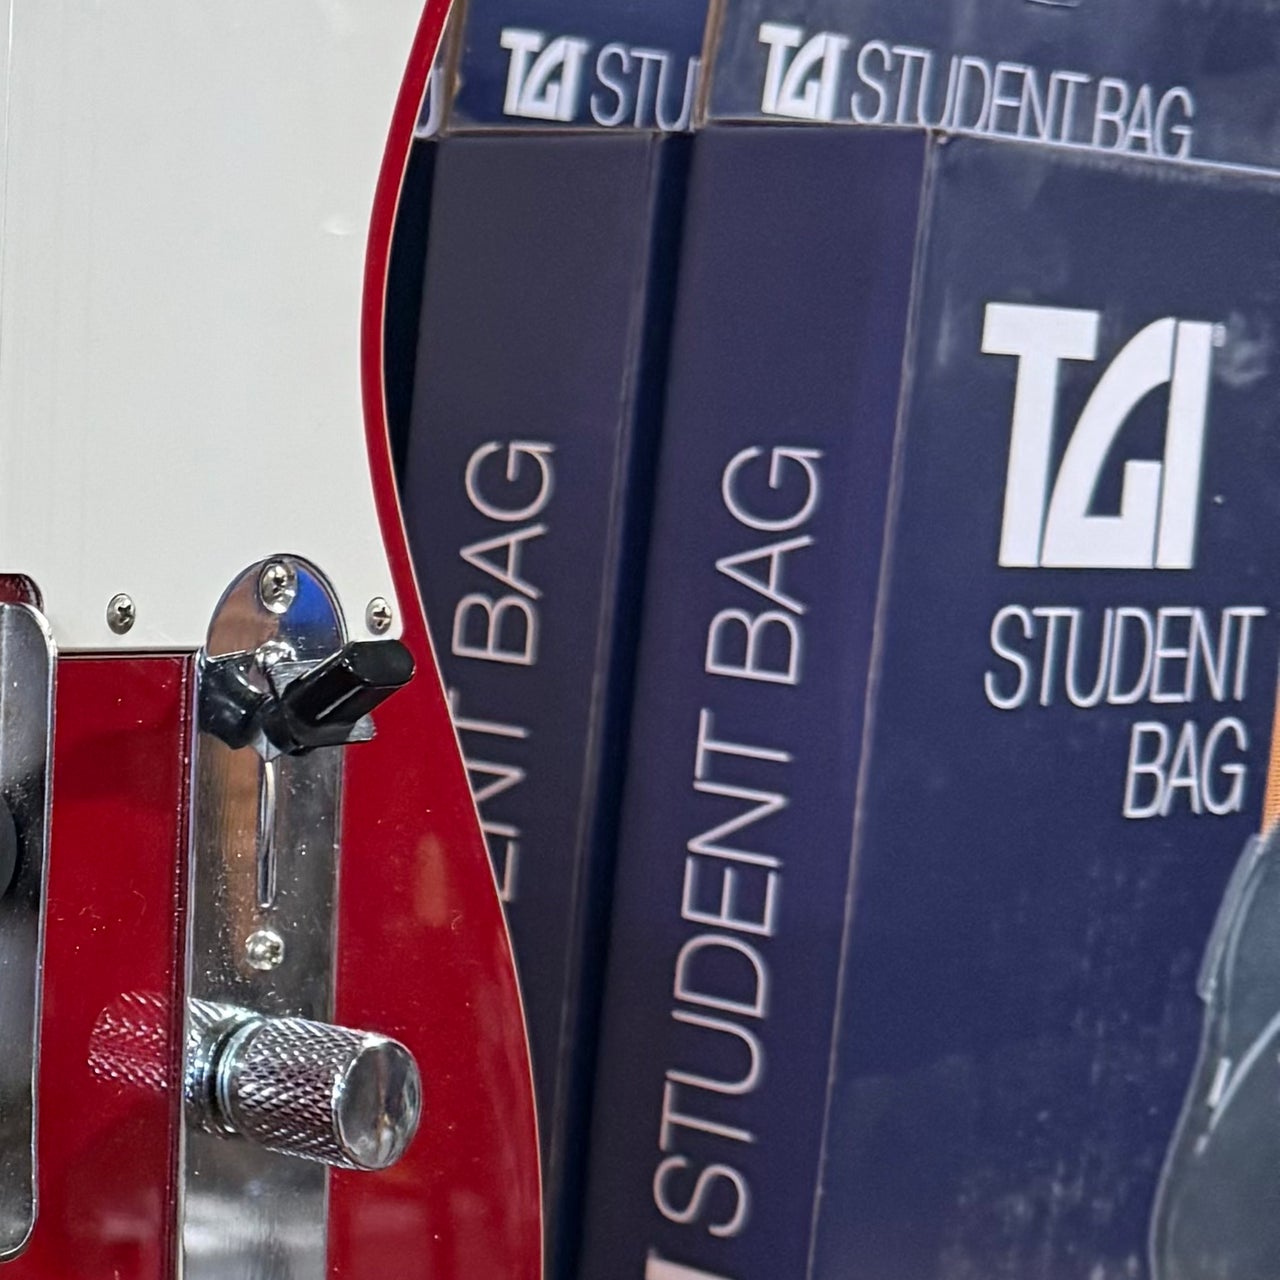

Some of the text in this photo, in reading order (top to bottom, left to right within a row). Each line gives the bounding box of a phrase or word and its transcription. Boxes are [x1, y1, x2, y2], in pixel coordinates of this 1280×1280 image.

[590, 42, 703, 135] STU
[850, 39, 1092, 144] STUDENT
[1092, 76, 1195, 162] BAG
[981, 302, 1214, 570] TGI
[451, 439, 556, 666] BAG
[704, 443, 824, 686] BAG
[984, 604, 1268, 710] STUDENT
[1122, 718, 1248, 818] BAG
[653, 710, 793, 1240] STUDENT
